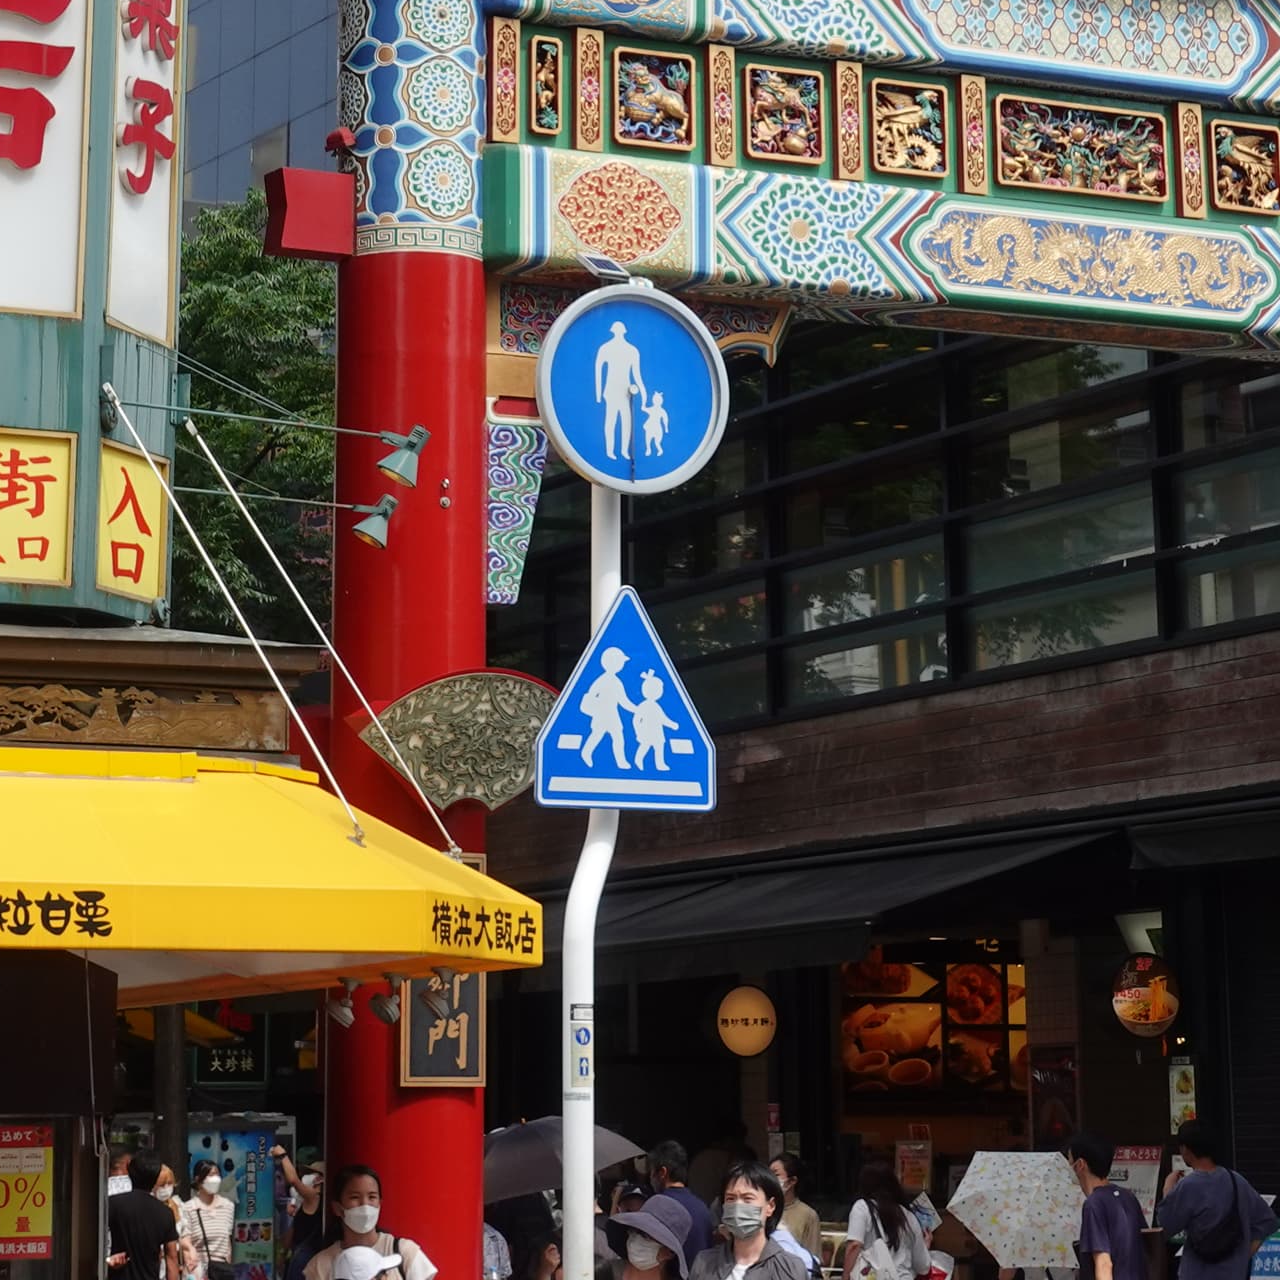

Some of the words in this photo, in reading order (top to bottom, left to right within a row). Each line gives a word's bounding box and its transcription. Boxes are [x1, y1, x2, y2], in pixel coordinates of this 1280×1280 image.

[107, 466, 153, 585] 入口
[433, 899, 537, 955] 横浜大飯店
